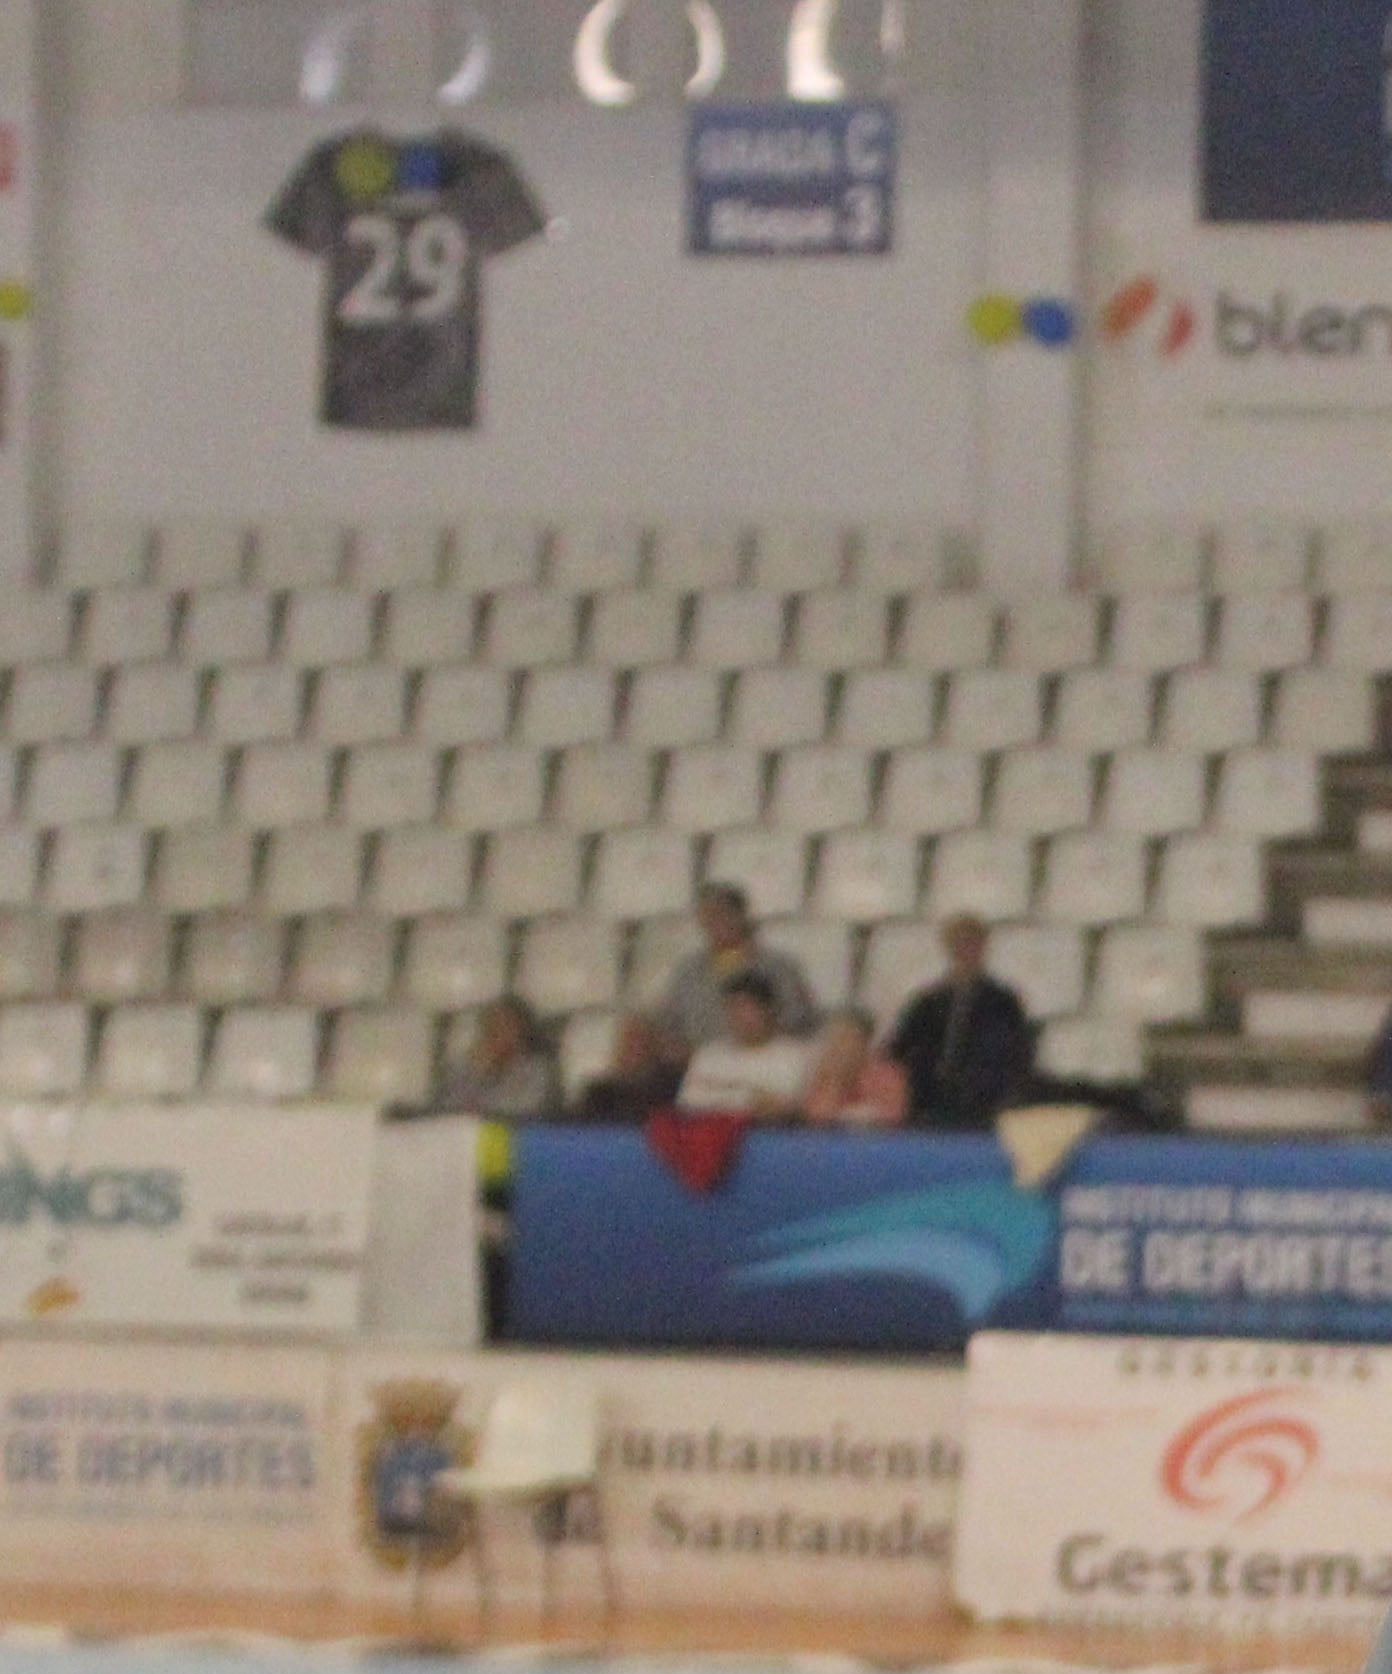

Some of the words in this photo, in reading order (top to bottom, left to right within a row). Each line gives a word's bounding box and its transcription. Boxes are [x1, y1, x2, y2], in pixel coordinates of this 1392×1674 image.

[340, 213, 467, 323] 29
[1062, 1229, 1130, 1292] DE
[650, 1497, 952, 1558] Santande
